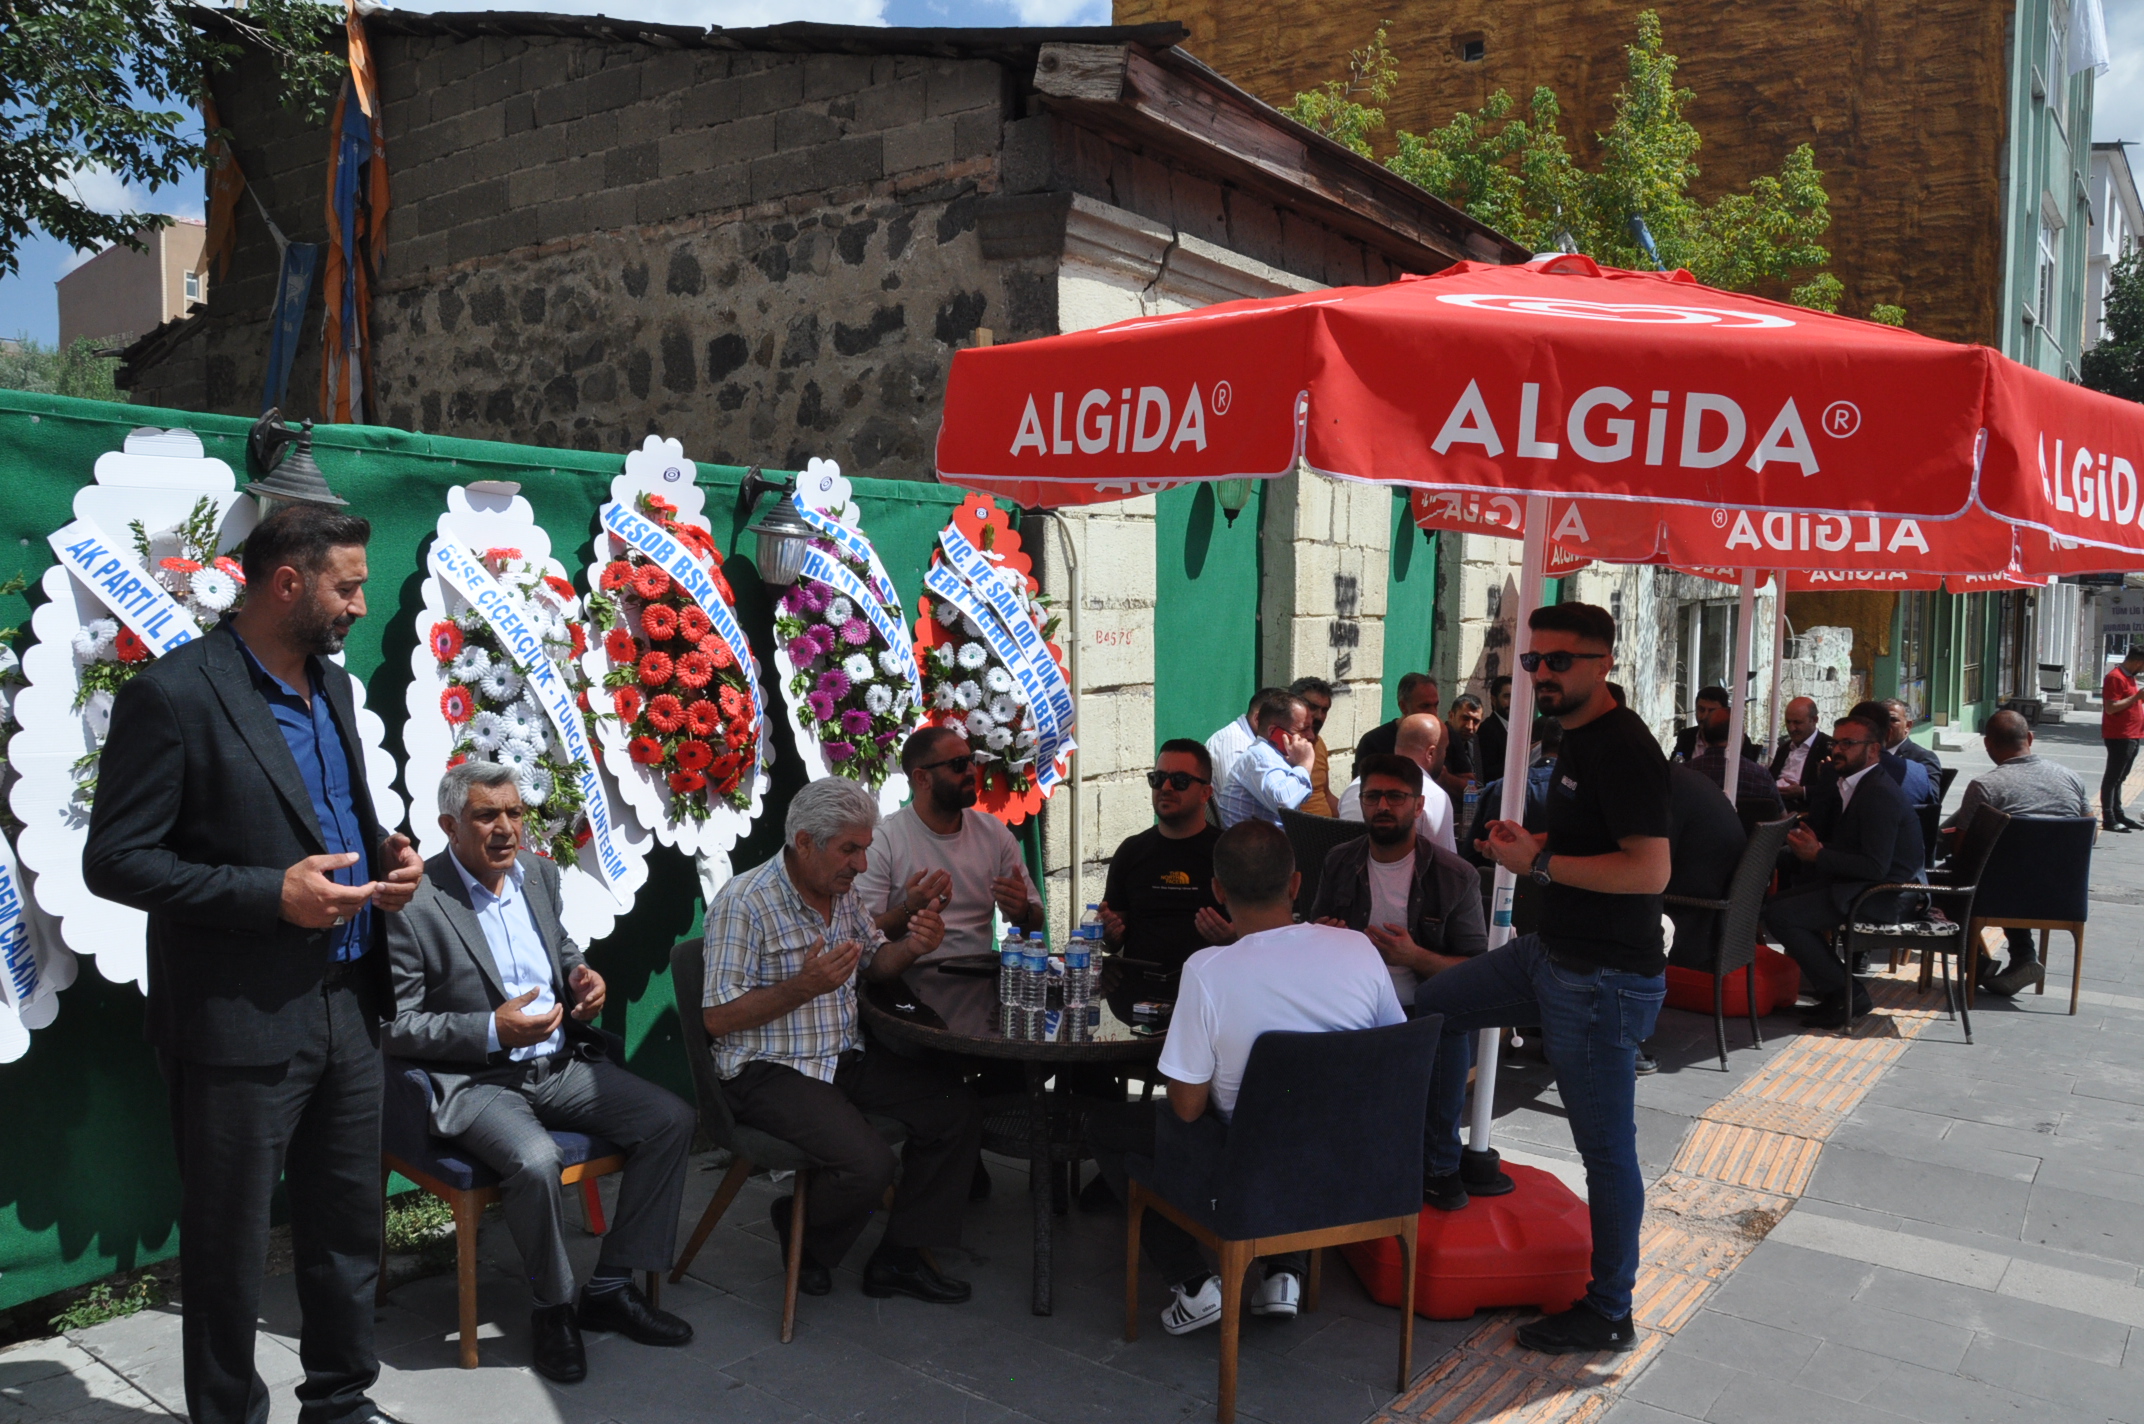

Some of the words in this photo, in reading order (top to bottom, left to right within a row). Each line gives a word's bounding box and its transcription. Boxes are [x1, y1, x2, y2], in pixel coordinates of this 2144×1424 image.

[1009, 381, 1207, 457] ALGiDA
[1430, 377, 1820, 477] ALGiDA
[605, 503, 676, 564] KESOB
[65, 538, 109, 570] AK
[92, 558, 164, 618] PARTİ
[142, 604, 174, 640] İL
[861, 593, 908, 662] GÖKALP
[943, 529, 972, 568] TİC.
[967, 560, 995, 586] VE
[986, 581, 1020, 624] SAN.
[1013, 620, 1037, 654] OD.
[1031, 648, 1060, 694] YÖN.
[474, 589, 556, 688] ÇİÇEKÇİLİK
[553, 694, 589, 766] TUNCAY
[580, 772, 627, 882] ALTUNTERİM
